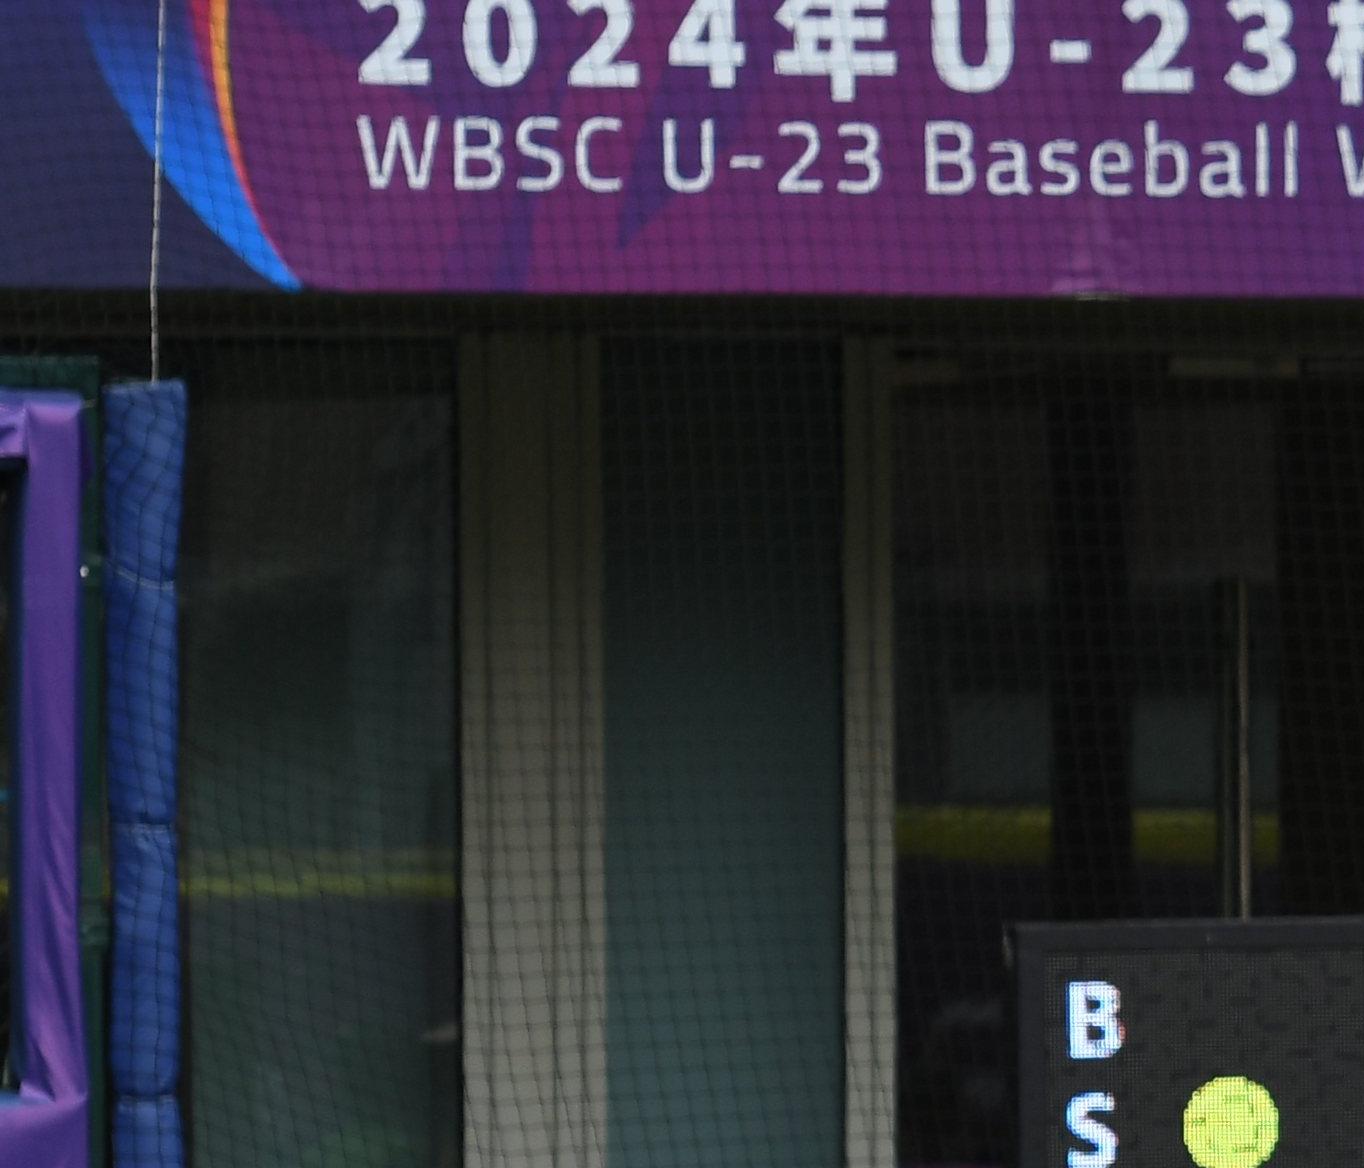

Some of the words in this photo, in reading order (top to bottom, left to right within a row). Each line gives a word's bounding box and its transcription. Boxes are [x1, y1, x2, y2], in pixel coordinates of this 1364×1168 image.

[356, 115, 622, 192] WBSC
[662, 118, 882, 194] U-23
[924, 120, 1298, 198] Baseball
[1067, 981, 1126, 1059] B
